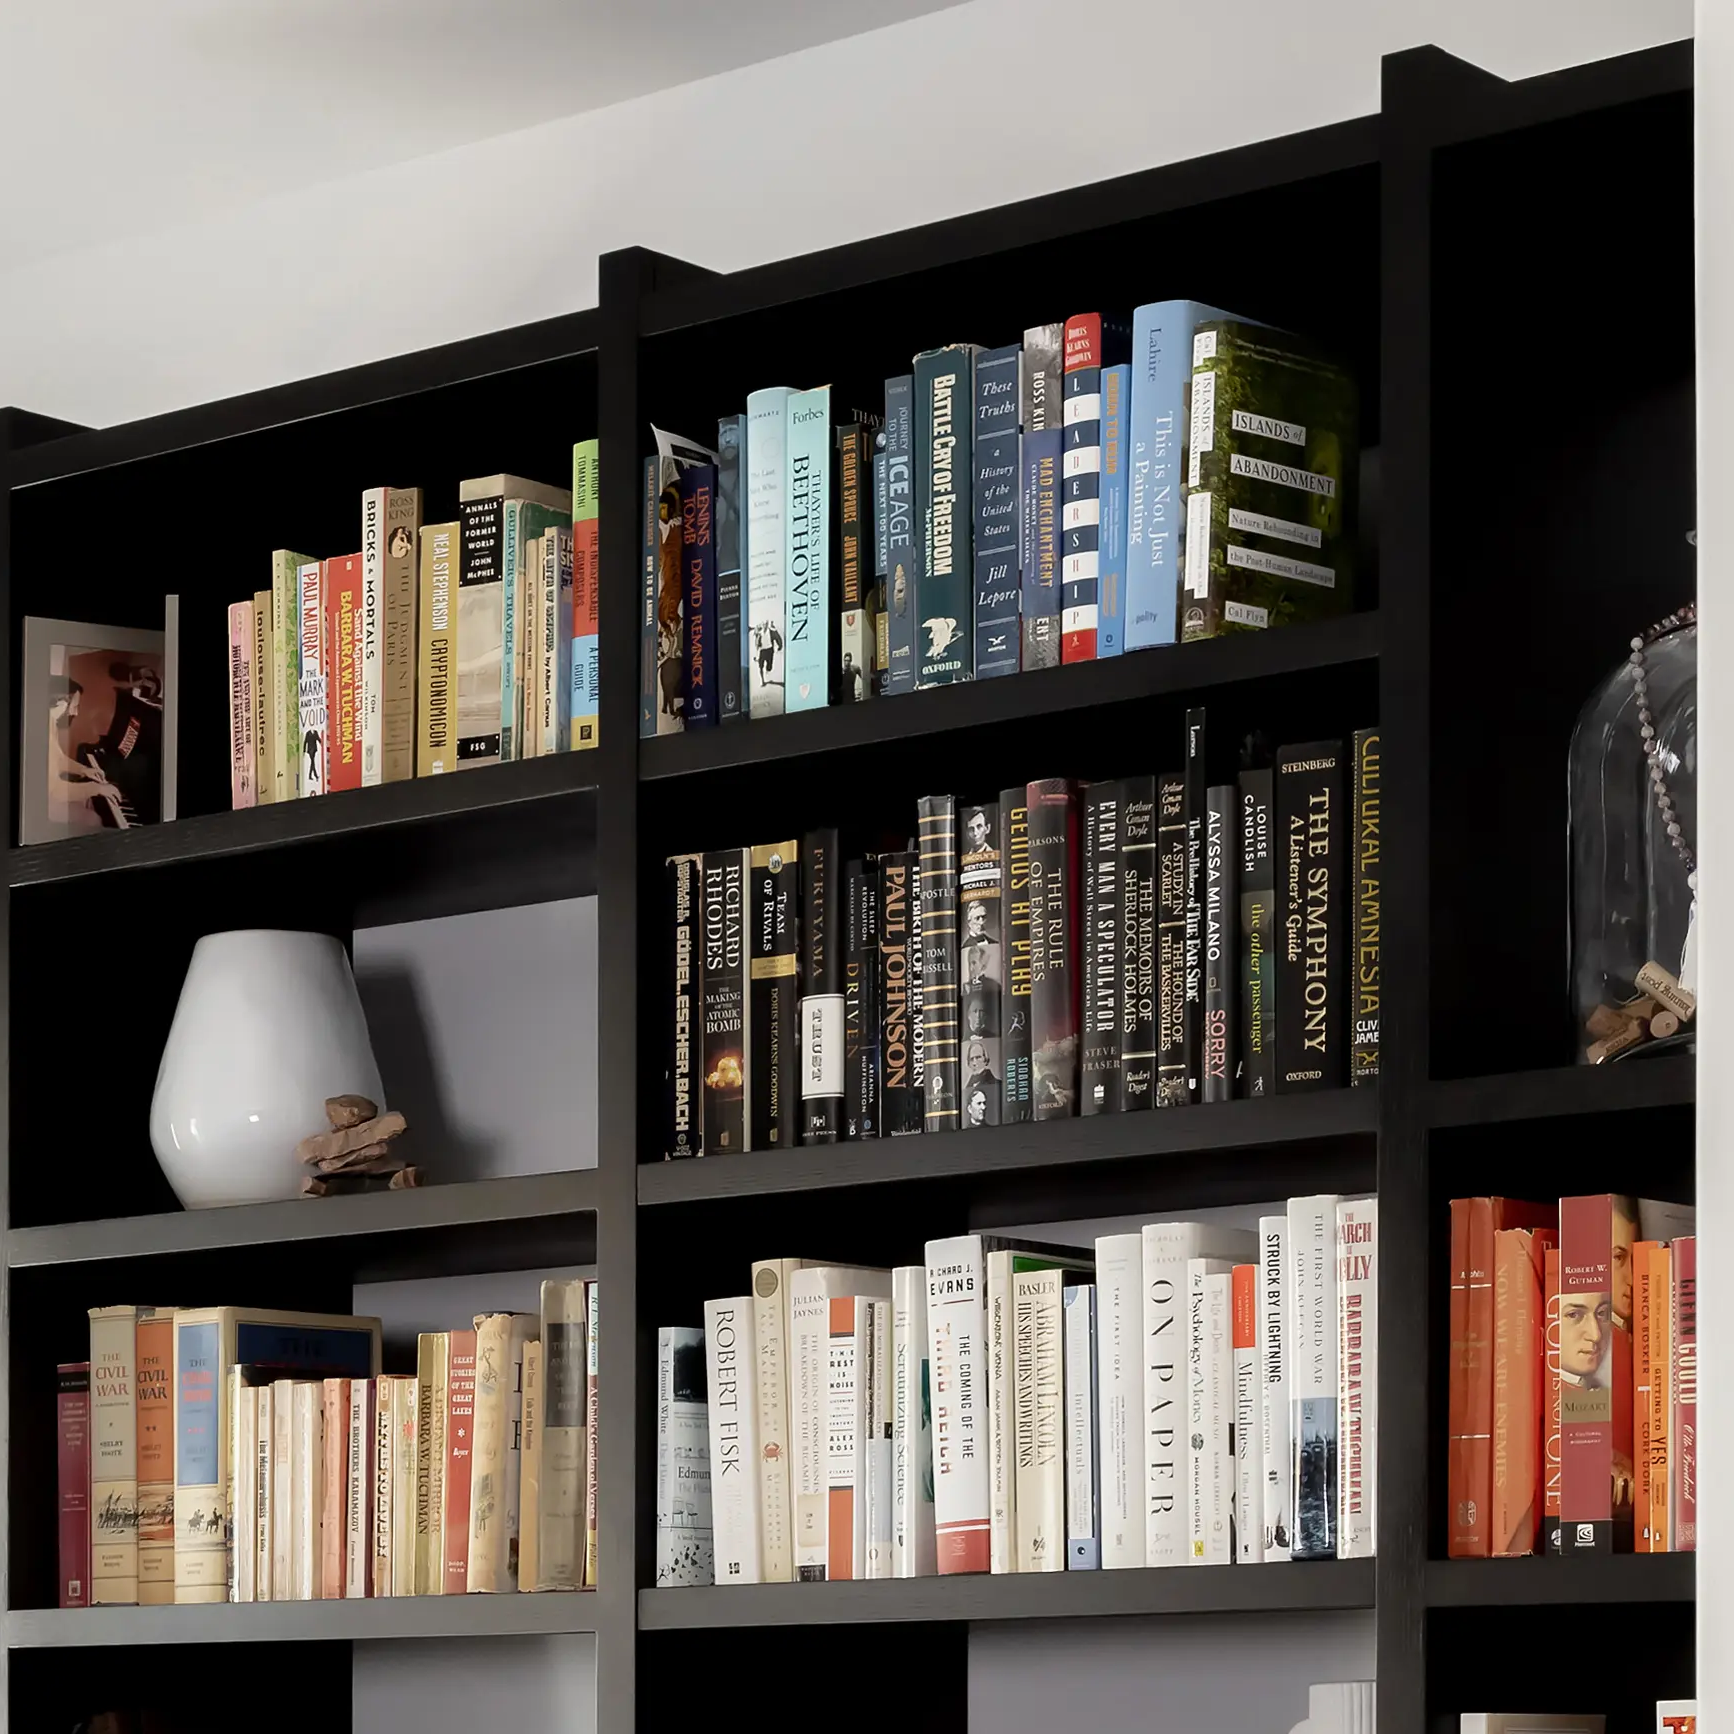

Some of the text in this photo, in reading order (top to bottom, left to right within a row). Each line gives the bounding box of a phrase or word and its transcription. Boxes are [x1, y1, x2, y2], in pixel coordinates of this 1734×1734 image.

[1148, 328, 1162, 382] Lahire
[982, 381, 1013, 396] These
[793, 409, 824, 424] Forbes
[978, 401, 1015, 418] Truths
[980, 464, 1014, 481] History
[1234, 457, 1334, 496] ABANDONMENT
[577, 455, 586, 509] TOMMASINI
[389, 497, 414, 509] ROSS
[465, 502, 498, 514] ANNALS
[889, 454, 909, 550] ICE AGE
[981, 503, 1013, 518] United
[388, 507, 414, 520] KING
[469, 513, 495, 524] OF THE
[465, 526, 496, 537] FORMER
[984, 522, 1010, 536] States
[468, 539, 495, 550] WORLD
[791, 454, 810, 642] BEETHOVEN
[471, 557, 491, 567] JOHN
[432, 533, 449, 631] NEAL STEPHENSON
[987, 564, 1008, 586] Jill
[978, 587, 1016, 608] Lepore
[303, 572, 318, 659] PAUL MURRAY
[691, 559, 703, 689] DAVID REMNICK
[922, 660, 961, 675] OXFORD
[574, 663, 584, 692] GUIDE
[300, 677, 323, 697] MARK
[429, 639, 448, 748] CRYPTONOMICON
[300, 709, 325, 728] VOID
[470, 741, 485, 751] FSG
[1281, 758, 1336, 774] STEINBERG
[1244, 794, 1254, 872] CANDLISH
[1256, 806, 1267, 859] LOUISE
[1207, 810, 1221, 962] ALYSSA MILANO
[706, 869, 722, 971] RHODES
[726, 865, 740, 968] RICHARD
[777, 892, 787, 935] TEAM
[1030, 860, 1045, 982] OF EMPIRES
[1049, 867, 1064, 969] THE RULE
[1304, 787, 1329, 1053] THE SYMPHONY
[926, 948, 946, 958] TOM
[1124, 869, 1137, 1034] SHERLOCK HOLMES
[1138, 878, 1153, 1021] THE MEMOIRS OF
[880, 866, 907, 1089] PAUL JOHNSON
[706, 992, 741, 1005] MAKING
[706, 1009, 740, 1021] ATOMIC
[706, 1019, 741, 1034] BOMB
[1286, 1070, 1322, 1082] OXFORD
[1565, 1264, 1607, 1274] ROBERT W.
[930, 1277, 974, 1296] EVANS
[1018, 1281, 1056, 1296] BASLER
[1568, 1276, 1603, 1285] GUTMAN
[1266, 1233, 1281, 1384] STRUCK BY LIGHTNING
[102, 1353, 120, 1361] THE
[143, 1357, 159, 1365] THE
[716, 1309, 738, 1411] ROBERT
[829, 1359, 854, 1368] REST
[96, 1366, 129, 1379] CIVIL
[138, 1369, 168, 1383] CIVIL
[96, 1383, 129, 1397] WAR
[139, 1386, 168, 1401] WAR
[452, 1394, 473, 1403] GREAT
[1150, 1278, 1174, 1516] ON PAPER
[452, 1407, 472, 1415] LAKES
[1238, 1362, 1255, 1460] Mindfulness
[1564, 1402, 1607, 1412] MOZART
[720, 1421, 740, 1476] FISK
